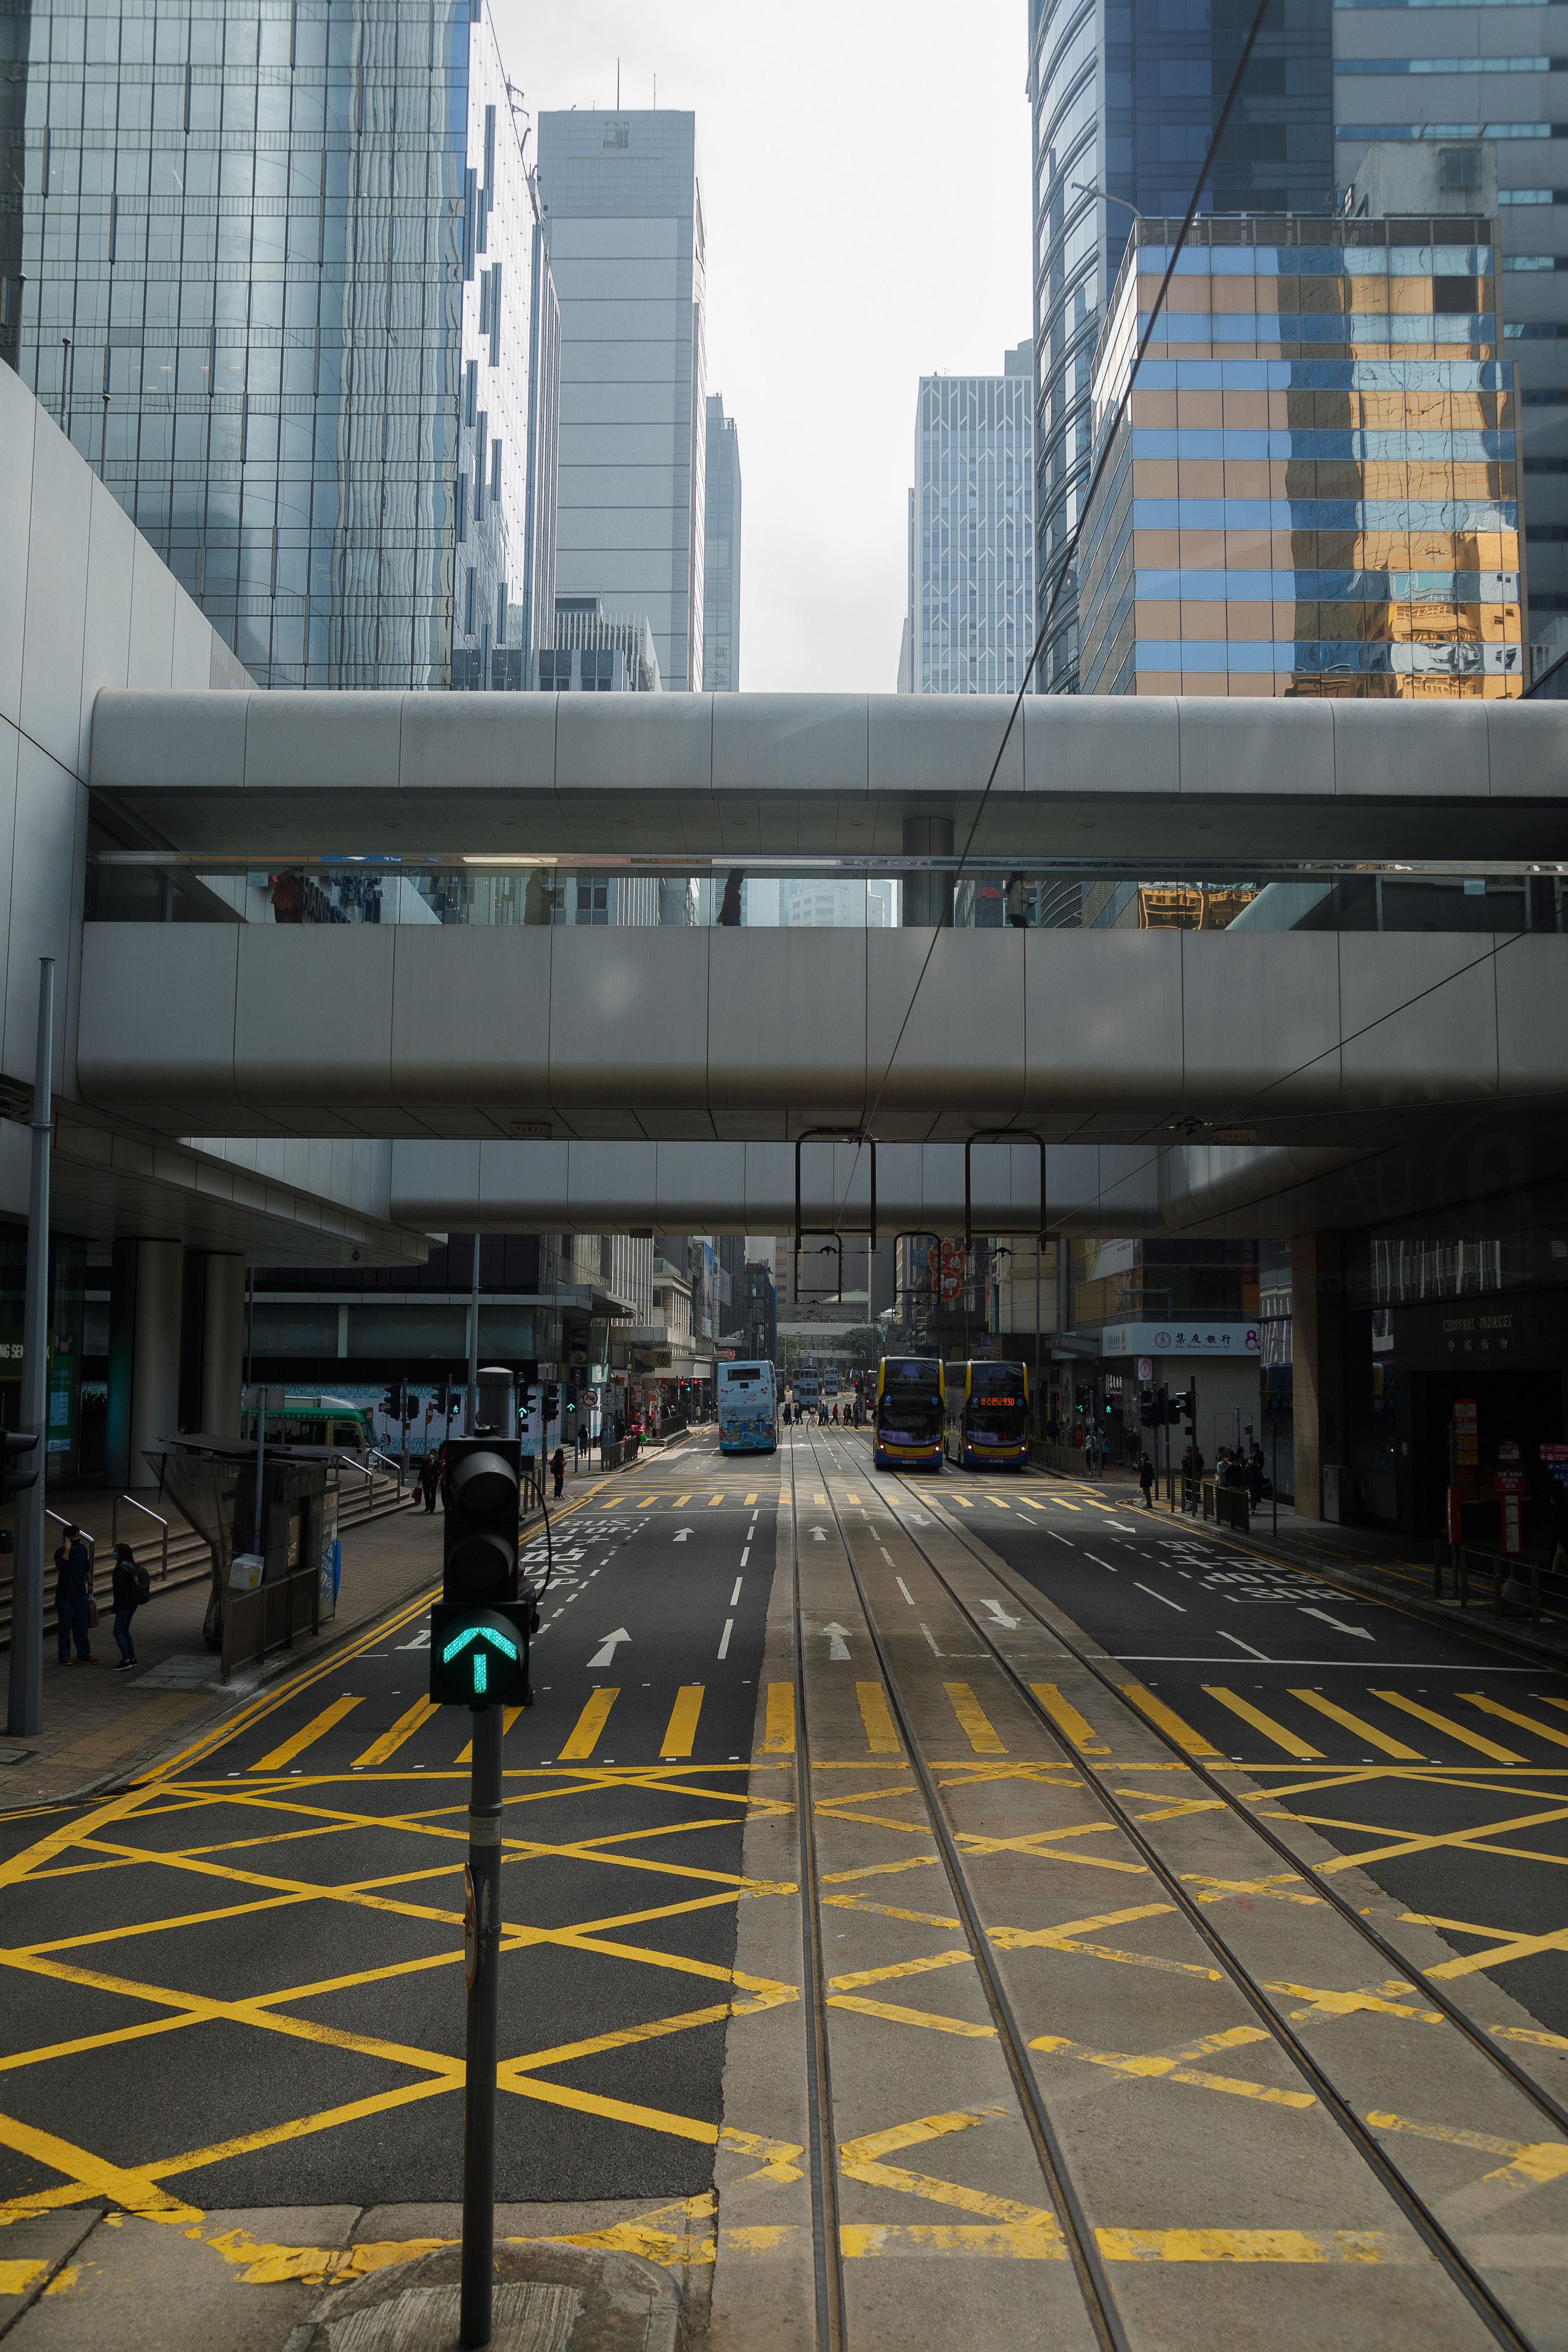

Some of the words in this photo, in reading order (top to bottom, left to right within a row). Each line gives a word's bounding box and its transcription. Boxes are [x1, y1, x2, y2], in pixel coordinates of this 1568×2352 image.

[1442, 1317, 1477, 1332] CENTRAL
[1479, 1314, 1514, 1330] MARKET
[1175, 1333, 1232, 1344] 集友銀行
[11, 1344, 24, 1359] SEN
[526, 1535, 610, 1548] 巴士
[1170, 1555, 1289, 1571] 巴士
[524, 1565, 582, 1575] US
[1204, 1572, 1326, 1585] STOP
[1240, 1587, 1357, 1600] BUS
